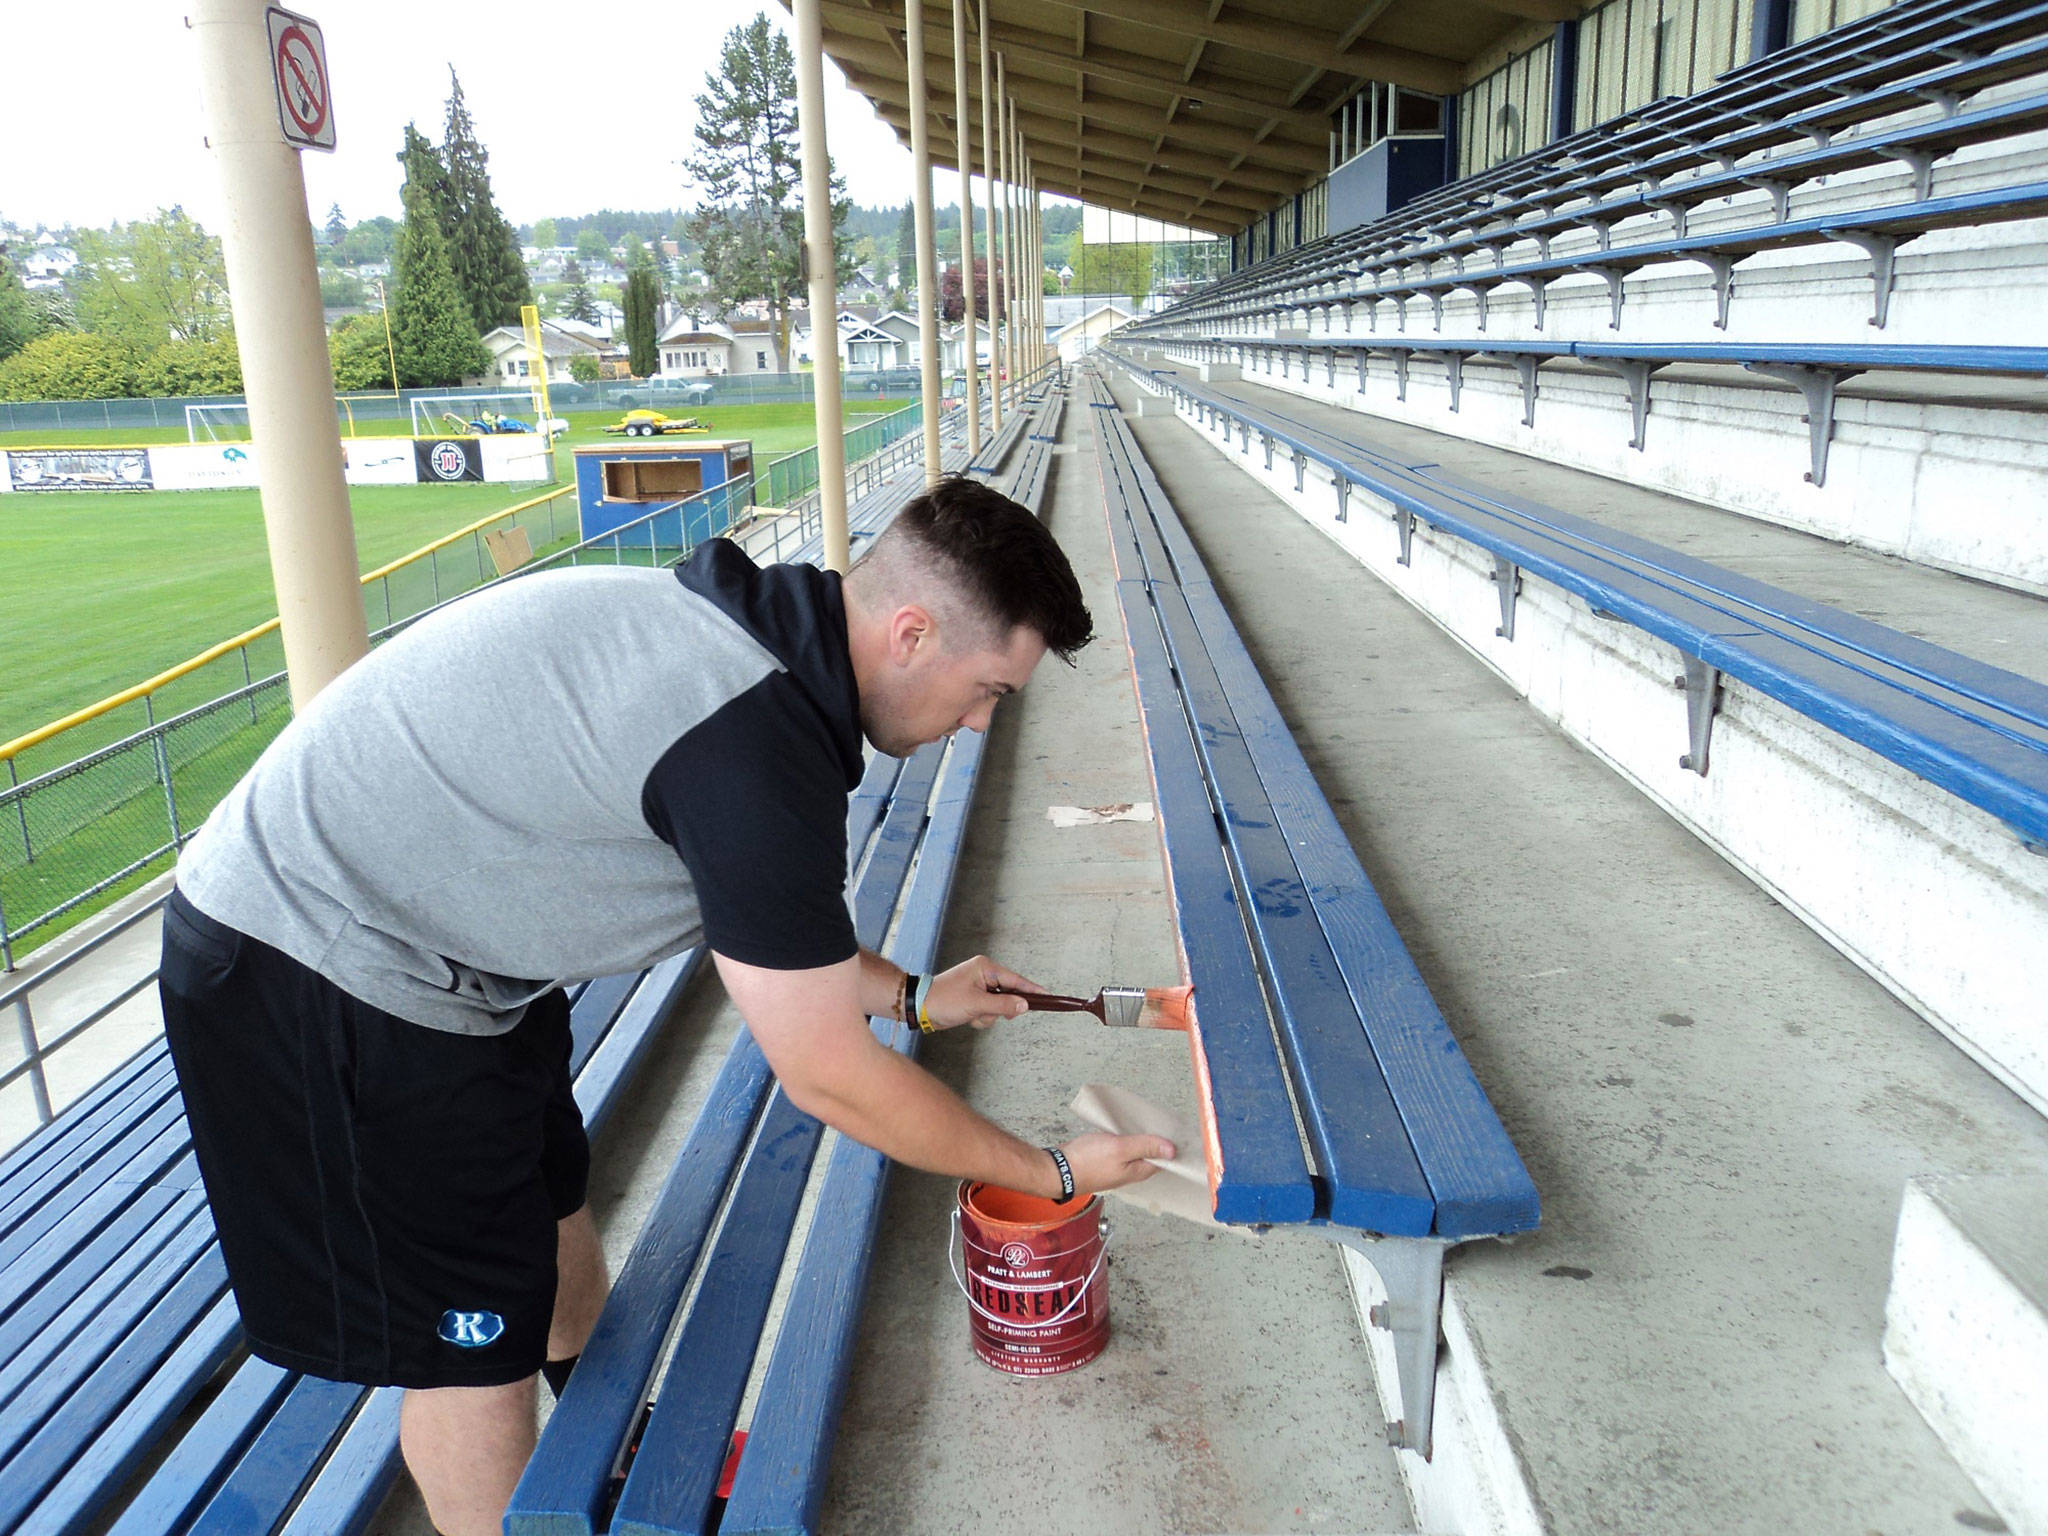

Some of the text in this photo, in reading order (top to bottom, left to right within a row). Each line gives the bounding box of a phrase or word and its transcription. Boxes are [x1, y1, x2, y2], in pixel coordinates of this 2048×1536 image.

[987, 1265, 1050, 1279] PRATT & LAMBERT
[987, 1321, 1037, 1338] SELF-PRIMING
[1039, 1327, 1062, 1338] PAINT
[1004, 1343, 1041, 1354] SEMI-GLOSS
